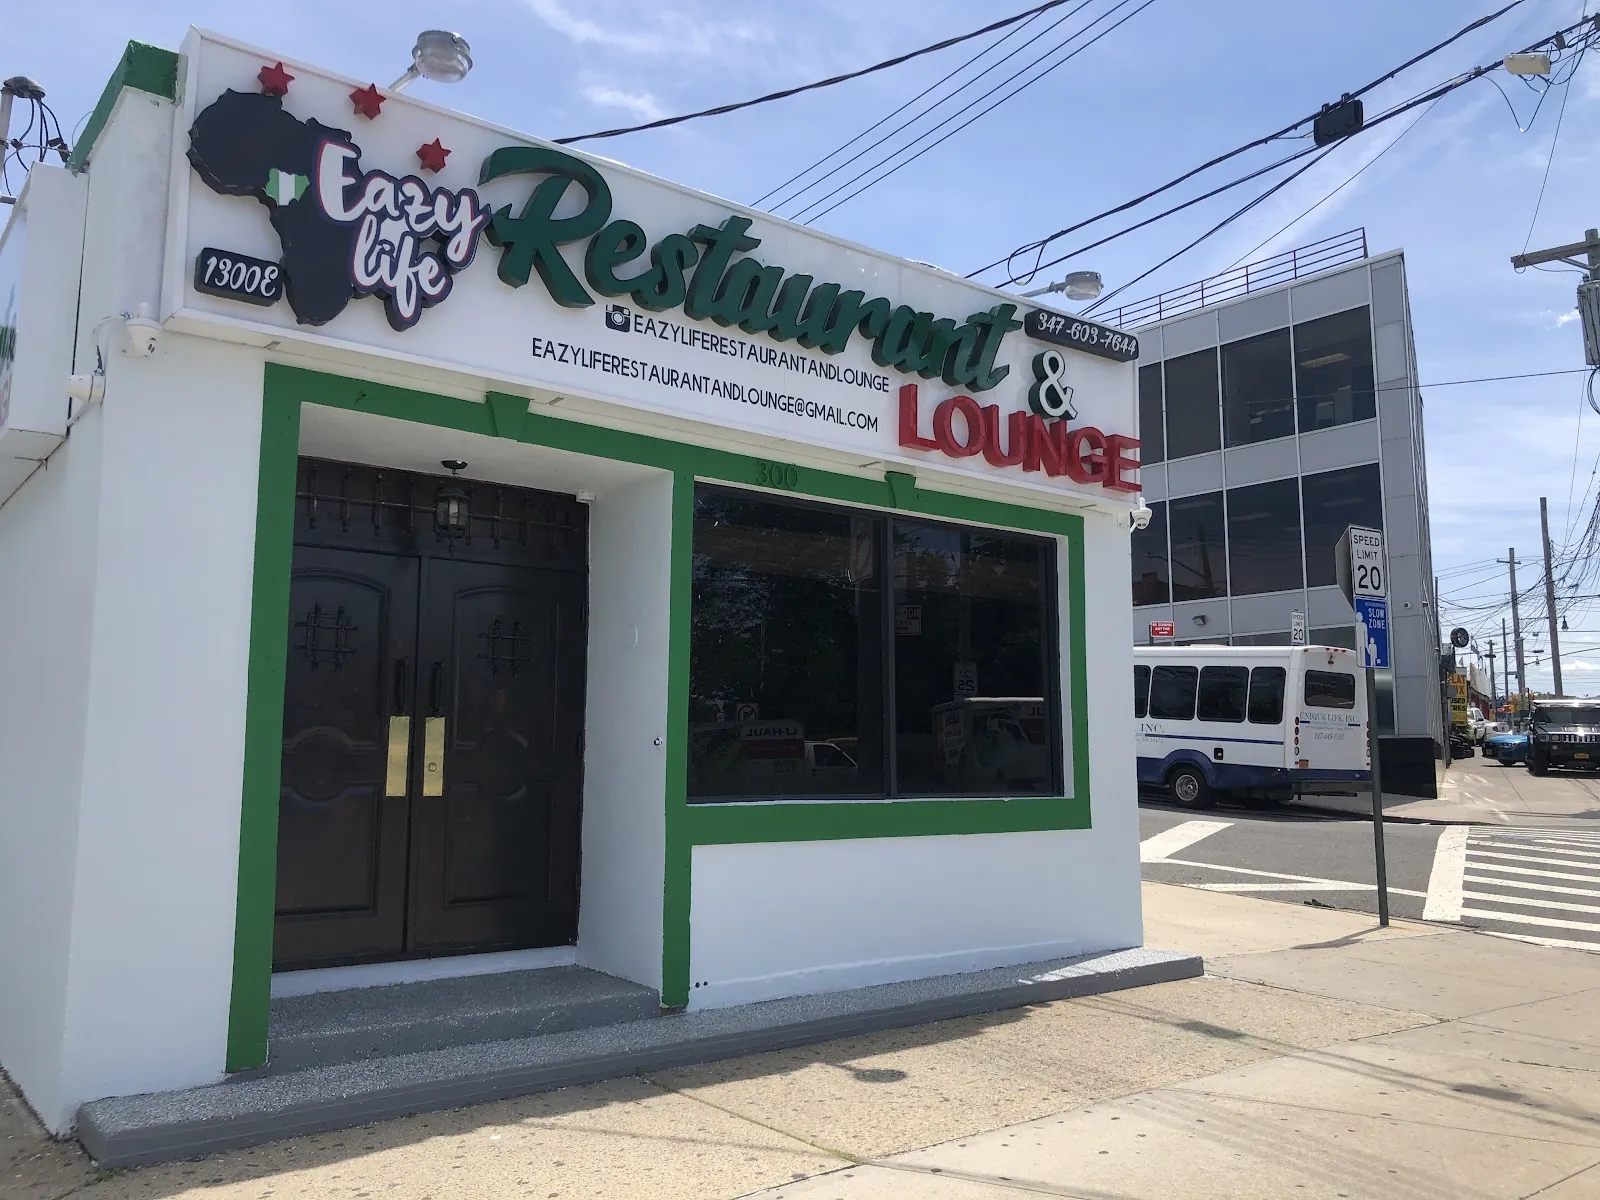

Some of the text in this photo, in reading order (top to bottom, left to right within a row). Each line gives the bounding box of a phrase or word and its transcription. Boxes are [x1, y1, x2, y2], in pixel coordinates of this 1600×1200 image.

[317, 138, 487, 260] Eazy
[476, 145, 1024, 394] Restaurant
[633, 314, 890, 393] EAZYLIFERESTAURANTANDLOUNGE
[532, 336, 879, 433] EAZYLIFERESTAURANTANDLOUNGE@GMAIL.COM
[1028, 349, 1078, 420] &
[898, 383, 1143, 493] LOUNGE
[757, 461, 799, 489] 300
[1353, 534, 1380, 547] SPEED
[1356, 549, 1378, 561] LIMIT
[1357, 564, 1381, 591] 20
[1368, 608, 1385, 619] SLOW
[1368, 618, 1386, 630] ZONE
[1293, 628, 1304, 641] 20
[1141, 723, 1165, 733] INC.
